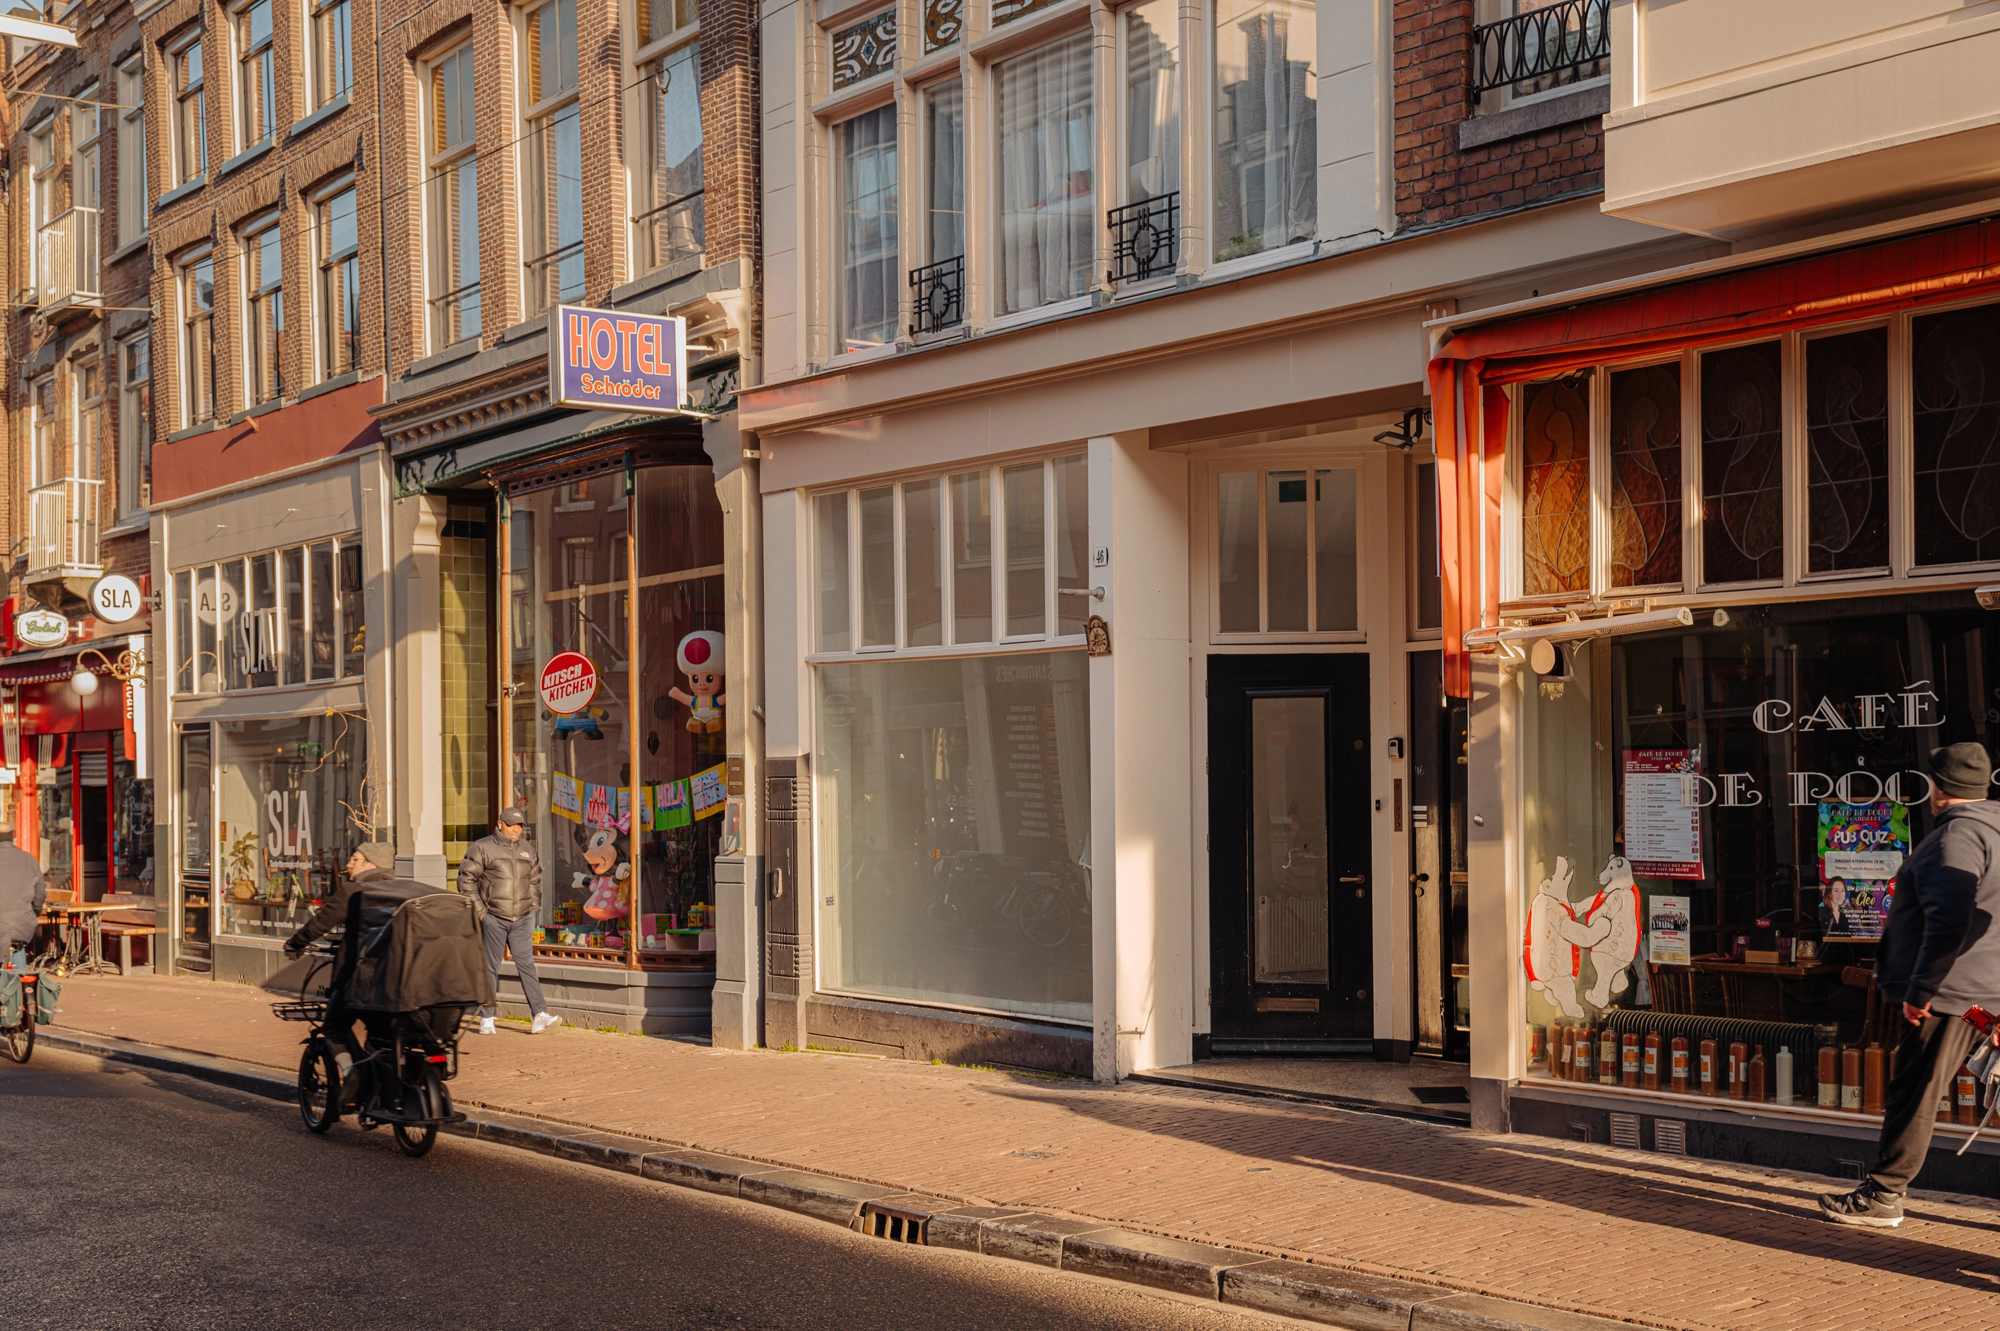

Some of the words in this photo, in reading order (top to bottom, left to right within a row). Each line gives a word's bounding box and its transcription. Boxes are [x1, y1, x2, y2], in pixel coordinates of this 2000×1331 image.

[569, 313, 671, 377] HOTEL
[580, 373, 661, 400] Schröder
[1096, 549, 1104, 563] 46
[101, 588, 133, 609] SLA
[26, 620, 62, 635] Grolsch
[241, 610, 268, 675] SLA
[543, 663, 583, 689] KITSCH
[549, 675, 594, 702] KITCHEN
[1752, 680, 1946, 734] CAFÉ
[592, 785, 607, 804] MA
[656, 781, 688, 812] HOLA
[1677, 772, 1763, 807] DE
[268, 789, 313, 857] SLA
[1867, 808, 1893, 816] POORT
[1833, 830, 1857, 844] PUB
[1860, 829, 1888, 845] QUIZ
[1855, 891, 1876, 906] Cleo
